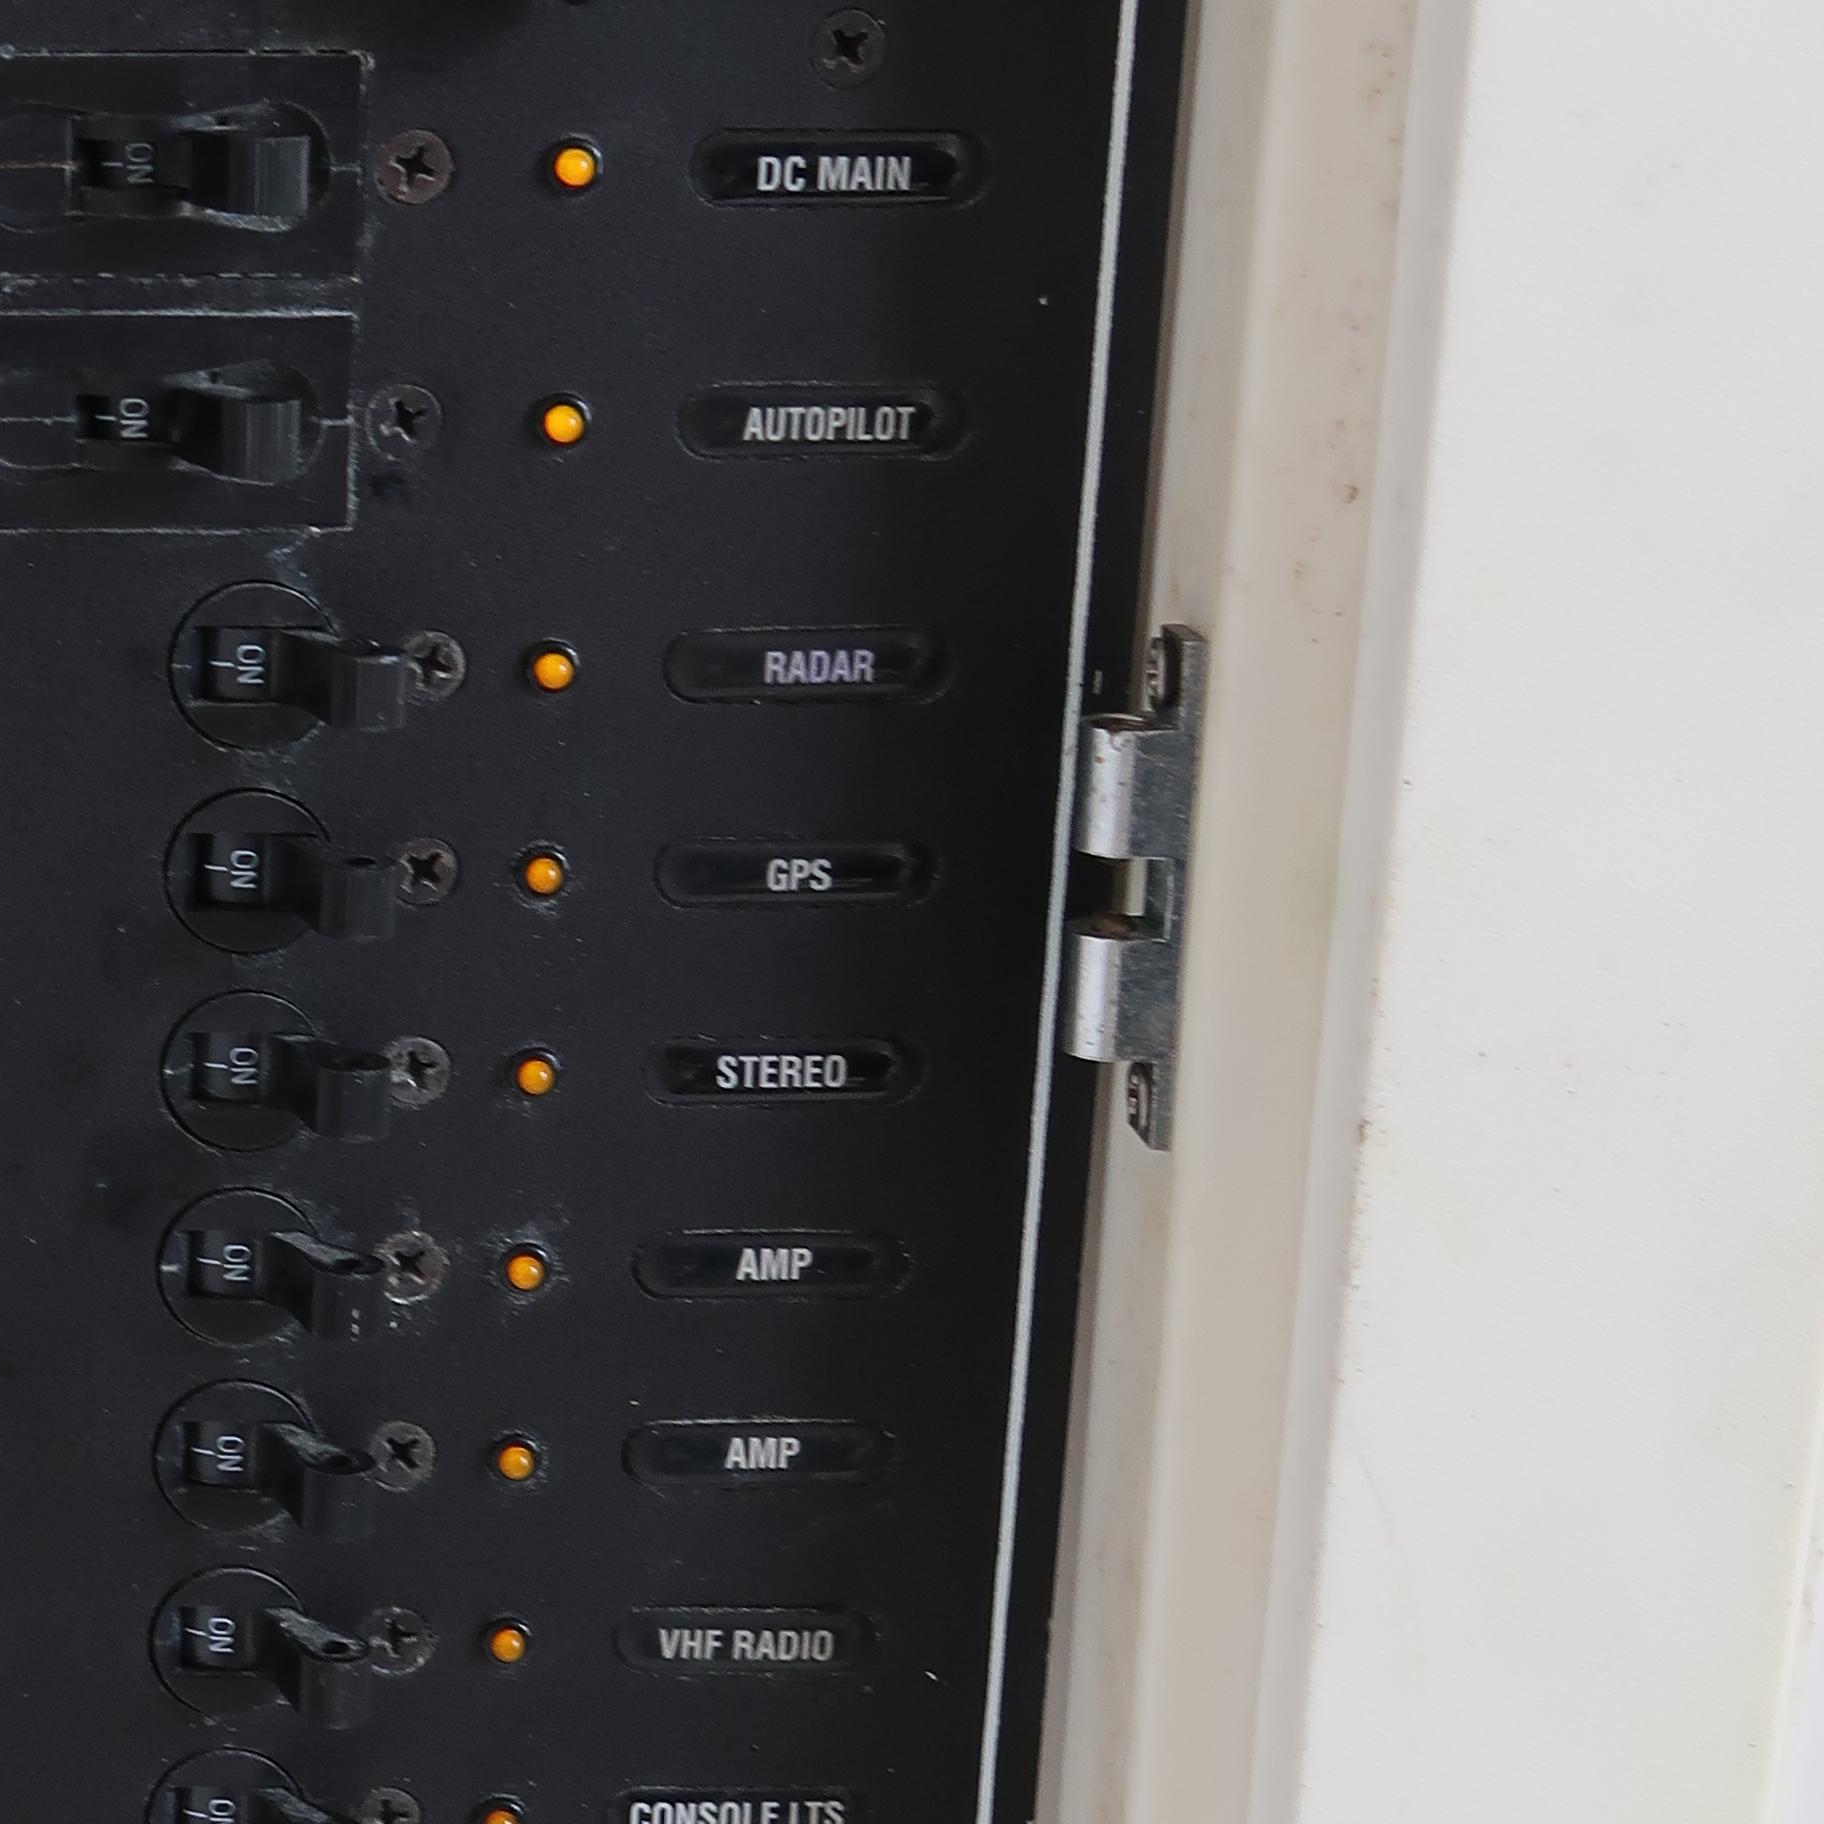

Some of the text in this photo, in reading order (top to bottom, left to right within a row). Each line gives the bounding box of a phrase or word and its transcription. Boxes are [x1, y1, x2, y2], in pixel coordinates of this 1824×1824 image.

[124, 142, 153, 184] ON
[757, 155, 911, 192] DC MAIN
[120, 398, 148, 438] ON
[743, 406, 915, 442] AUTOPILOT
[237, 644, 264, 684] ON
[765, 649, 873, 683] RADAR
[230, 850, 257, 888] ON
[767, 858, 832, 891] GPS
[230, 1047, 257, 1084] ON
[716, 1055, 846, 1089] STEREO
[223, 1245, 250, 1281] ON
[736, 1247, 812, 1281] AMP
[217, 1436, 244, 1471] ON
[725, 1436, 800, 1469] AMP
[209, 1617, 234, 1652] ON
[659, 1628, 832, 1661] VHF RADIO
